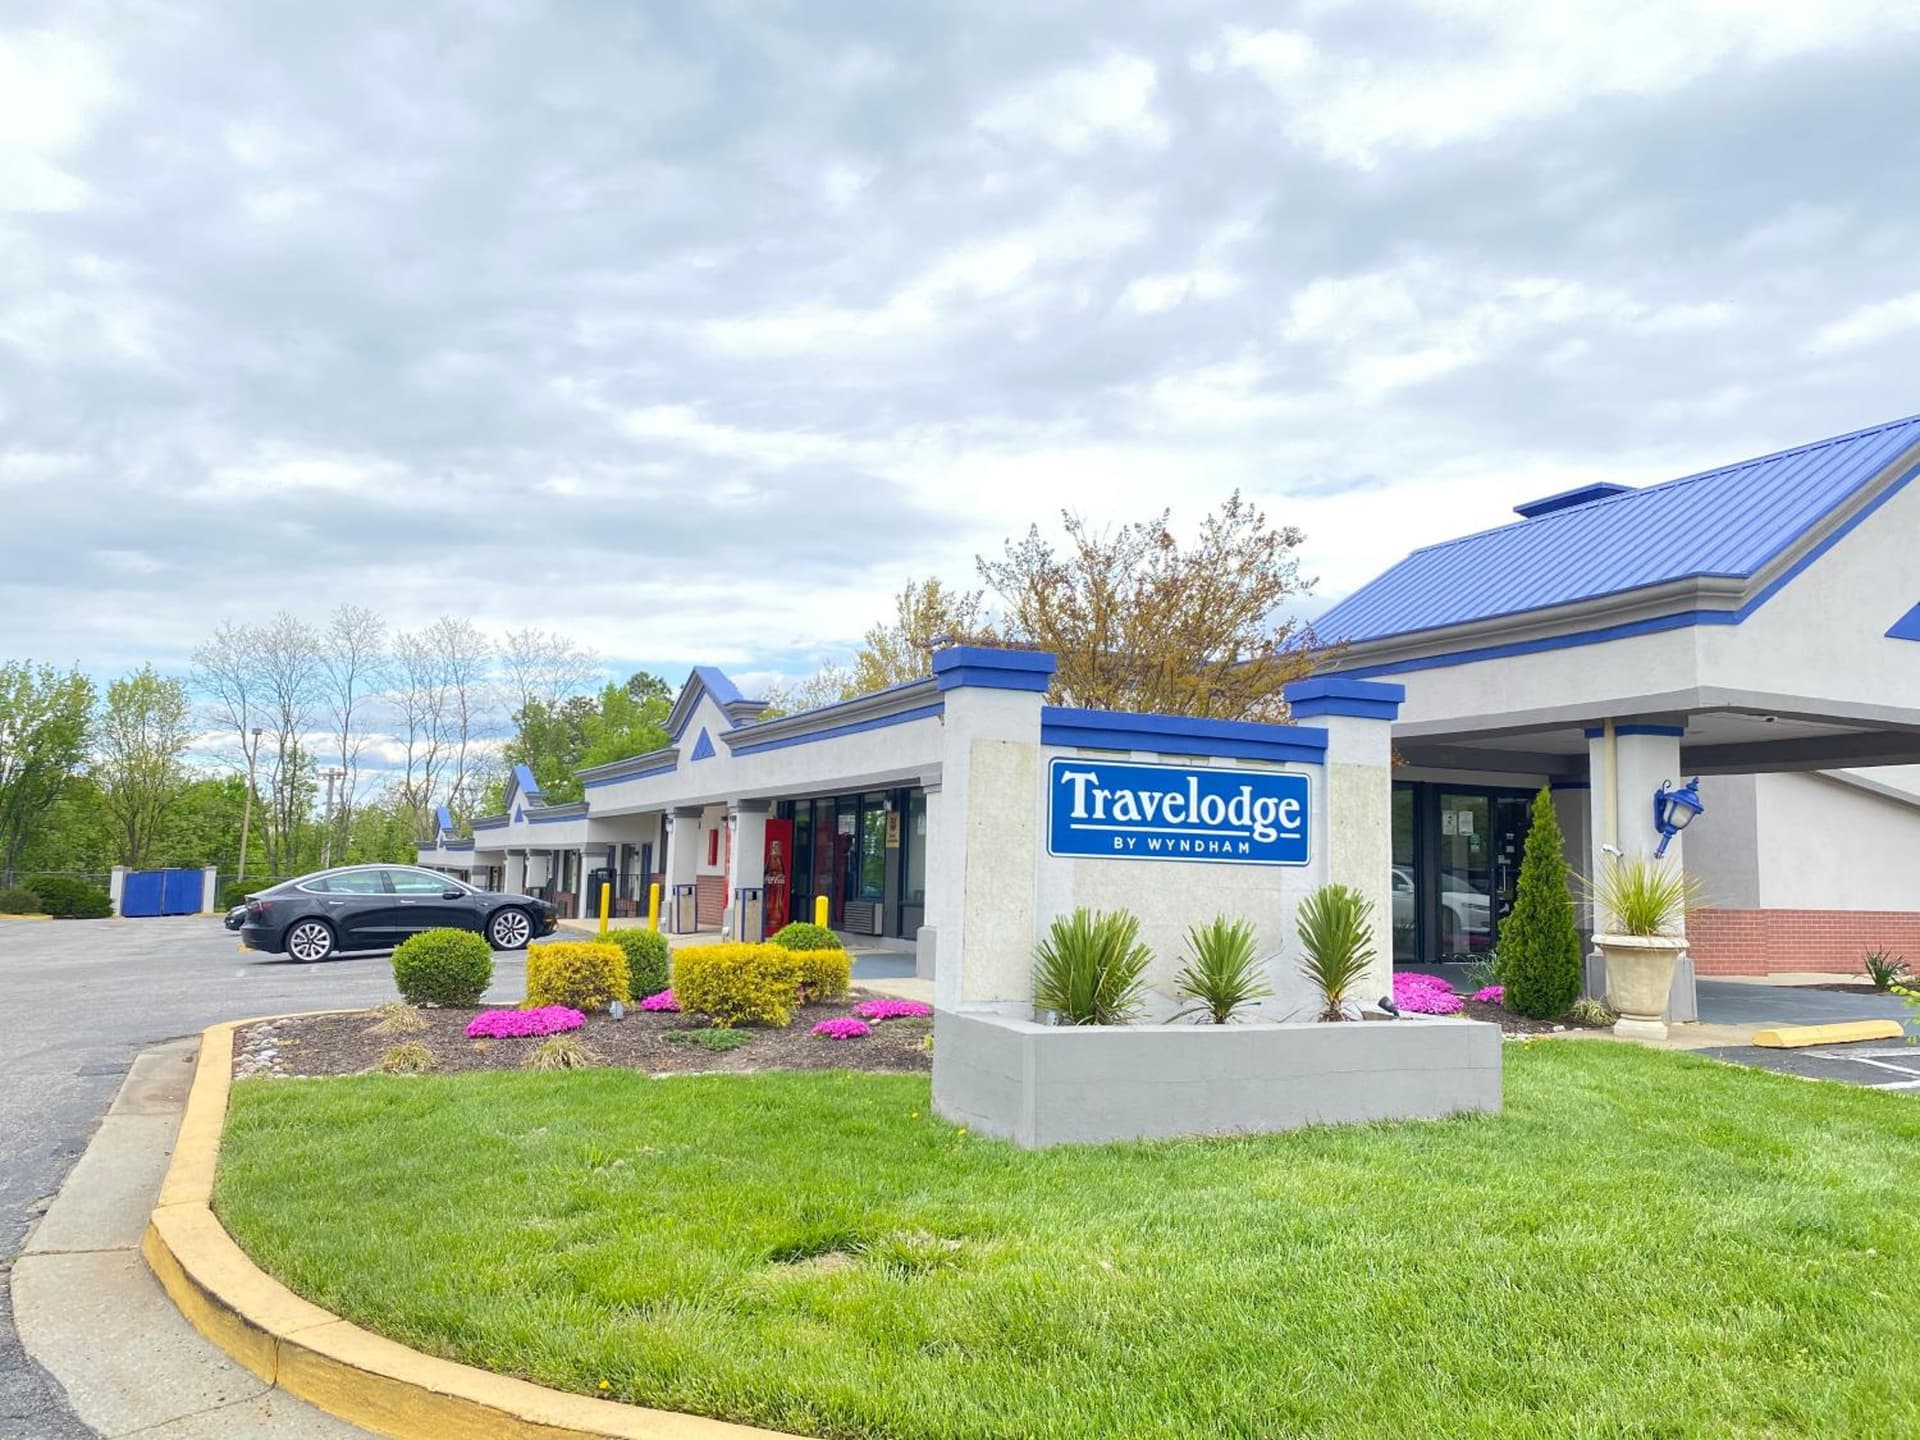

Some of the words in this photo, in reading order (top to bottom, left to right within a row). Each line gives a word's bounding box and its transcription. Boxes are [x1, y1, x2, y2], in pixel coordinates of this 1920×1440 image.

[1061, 770, 1300, 843] Travelodge
[1113, 836, 1136, 850] BY
[1147, 838, 1250, 854] WYNDHAM
